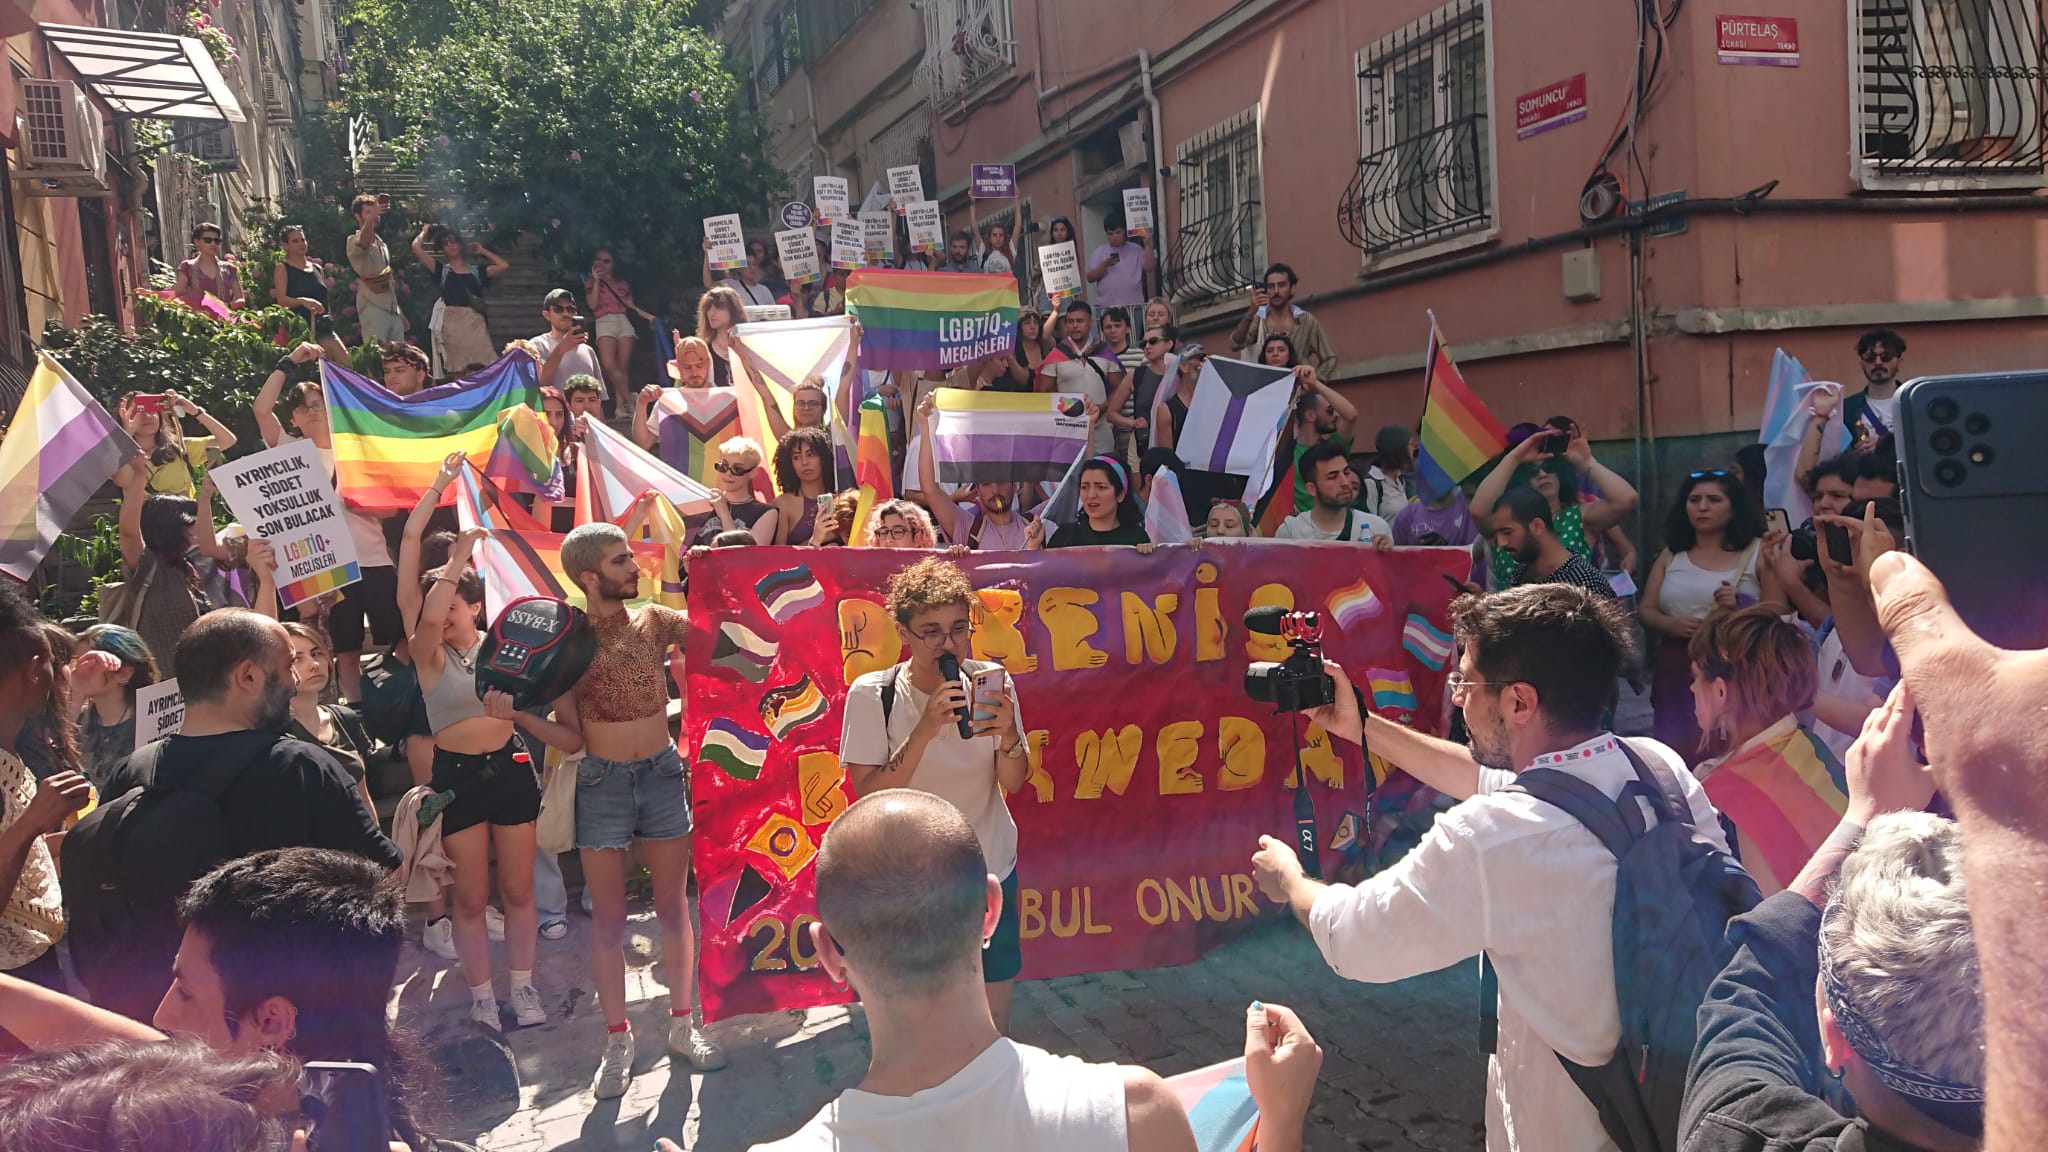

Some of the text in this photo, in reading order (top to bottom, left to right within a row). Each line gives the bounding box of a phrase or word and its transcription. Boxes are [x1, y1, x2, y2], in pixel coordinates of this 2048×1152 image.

[1721, 19, 1778, 40] PÜRTELAŞ
[1519, 87, 1566, 115] SOMUNCU
[939, 312, 1012, 342] LGBTİQ+
[940, 332, 1010, 365] MECLİSLERİ
[234, 455, 310, 488] AYRIMCILIK,
[258, 475, 302, 500] ŞİDDET
[253, 488, 324, 520] YOKSULLUK
[256, 504, 335, 538] SON BULACAK
[283, 533, 330, 562] LGBTİQ+
[290, 552, 337, 579] MECLİSLERİ
[507, 609, 560, 634] X-BASS
[147, 692, 184, 716] AYRIMCIL
[157, 708, 184, 734] ŞİDDET
[1020, 873, 1260, 939] BUL ONUR
